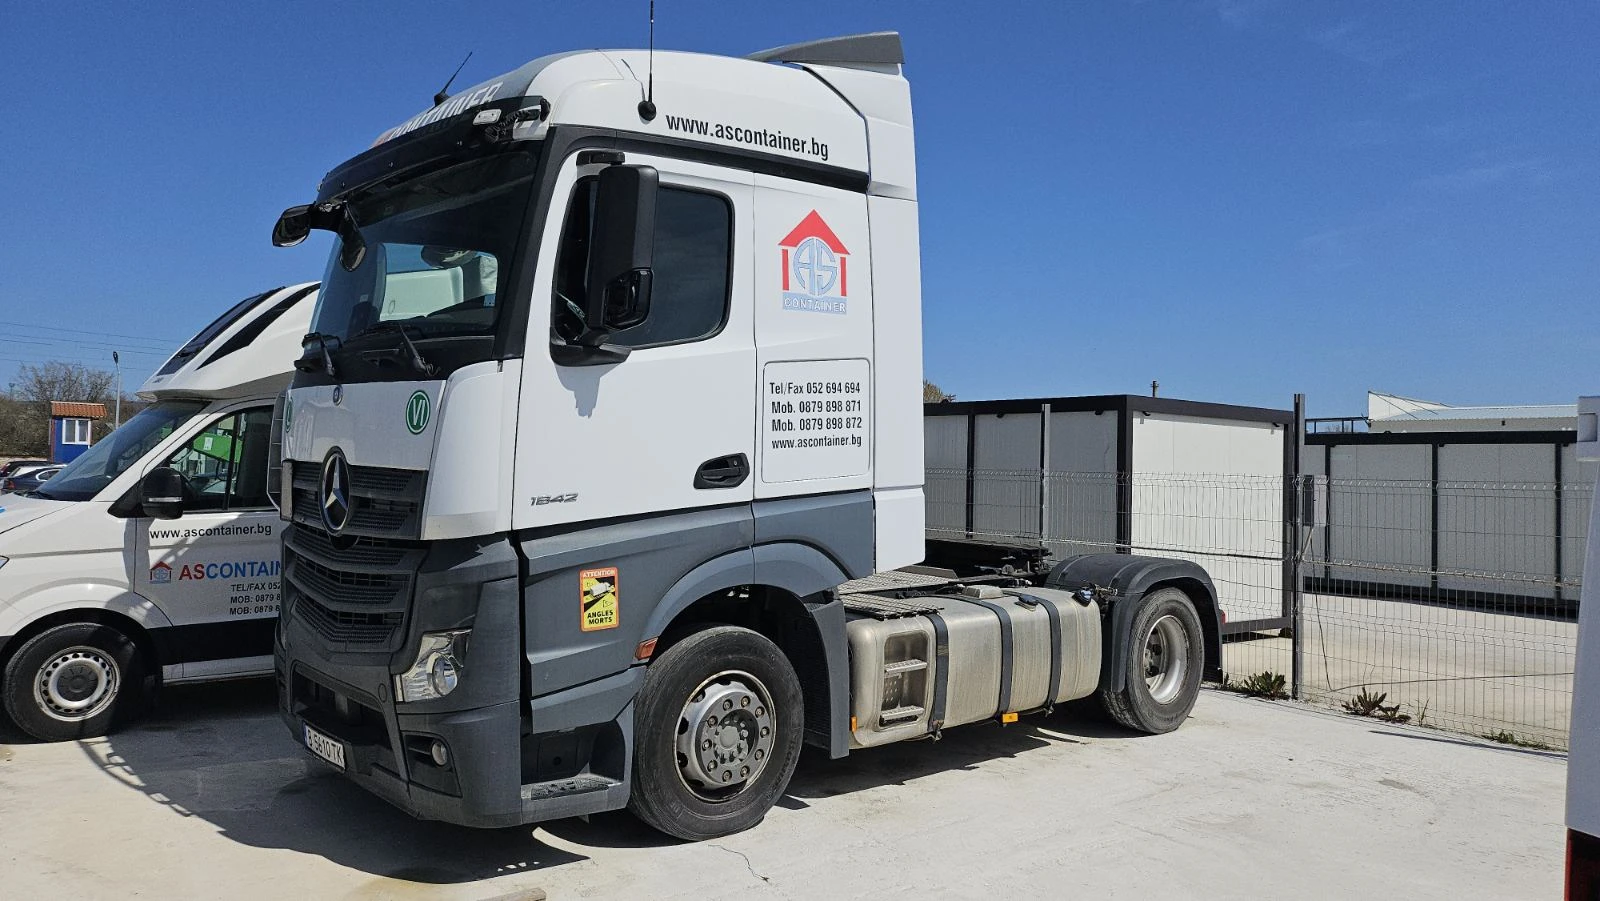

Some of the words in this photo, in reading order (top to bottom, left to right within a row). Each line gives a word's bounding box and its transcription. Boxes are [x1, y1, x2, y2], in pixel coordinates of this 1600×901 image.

[665, 114, 829, 161] www.ascontainer.bg
[784, 297, 846, 313] CONTAINER
[769, 382, 804, 395] Tel/Fax
[806, 382, 823, 394] 052
[826, 382, 842, 394] 694
[845, 382, 860, 394] 694
[771, 401, 796, 413] Mob.
[799, 400, 823, 413] 0879
[826, 400, 843, 412] 898
[845, 400, 861, 412] 871
[771, 419, 796, 432] Mob.
[799, 418, 823, 431] 0879
[826, 417, 843, 429] 898
[845, 417, 862, 429] 872
[771, 434, 862, 449] www.ascontainer.bg
[149, 524, 272, 539] www.ascontainer.bg
[230, 582, 266, 592] TEL/FAX
[587, 610, 614, 619] ANGLES
[588, 617, 613, 625] MORTS
